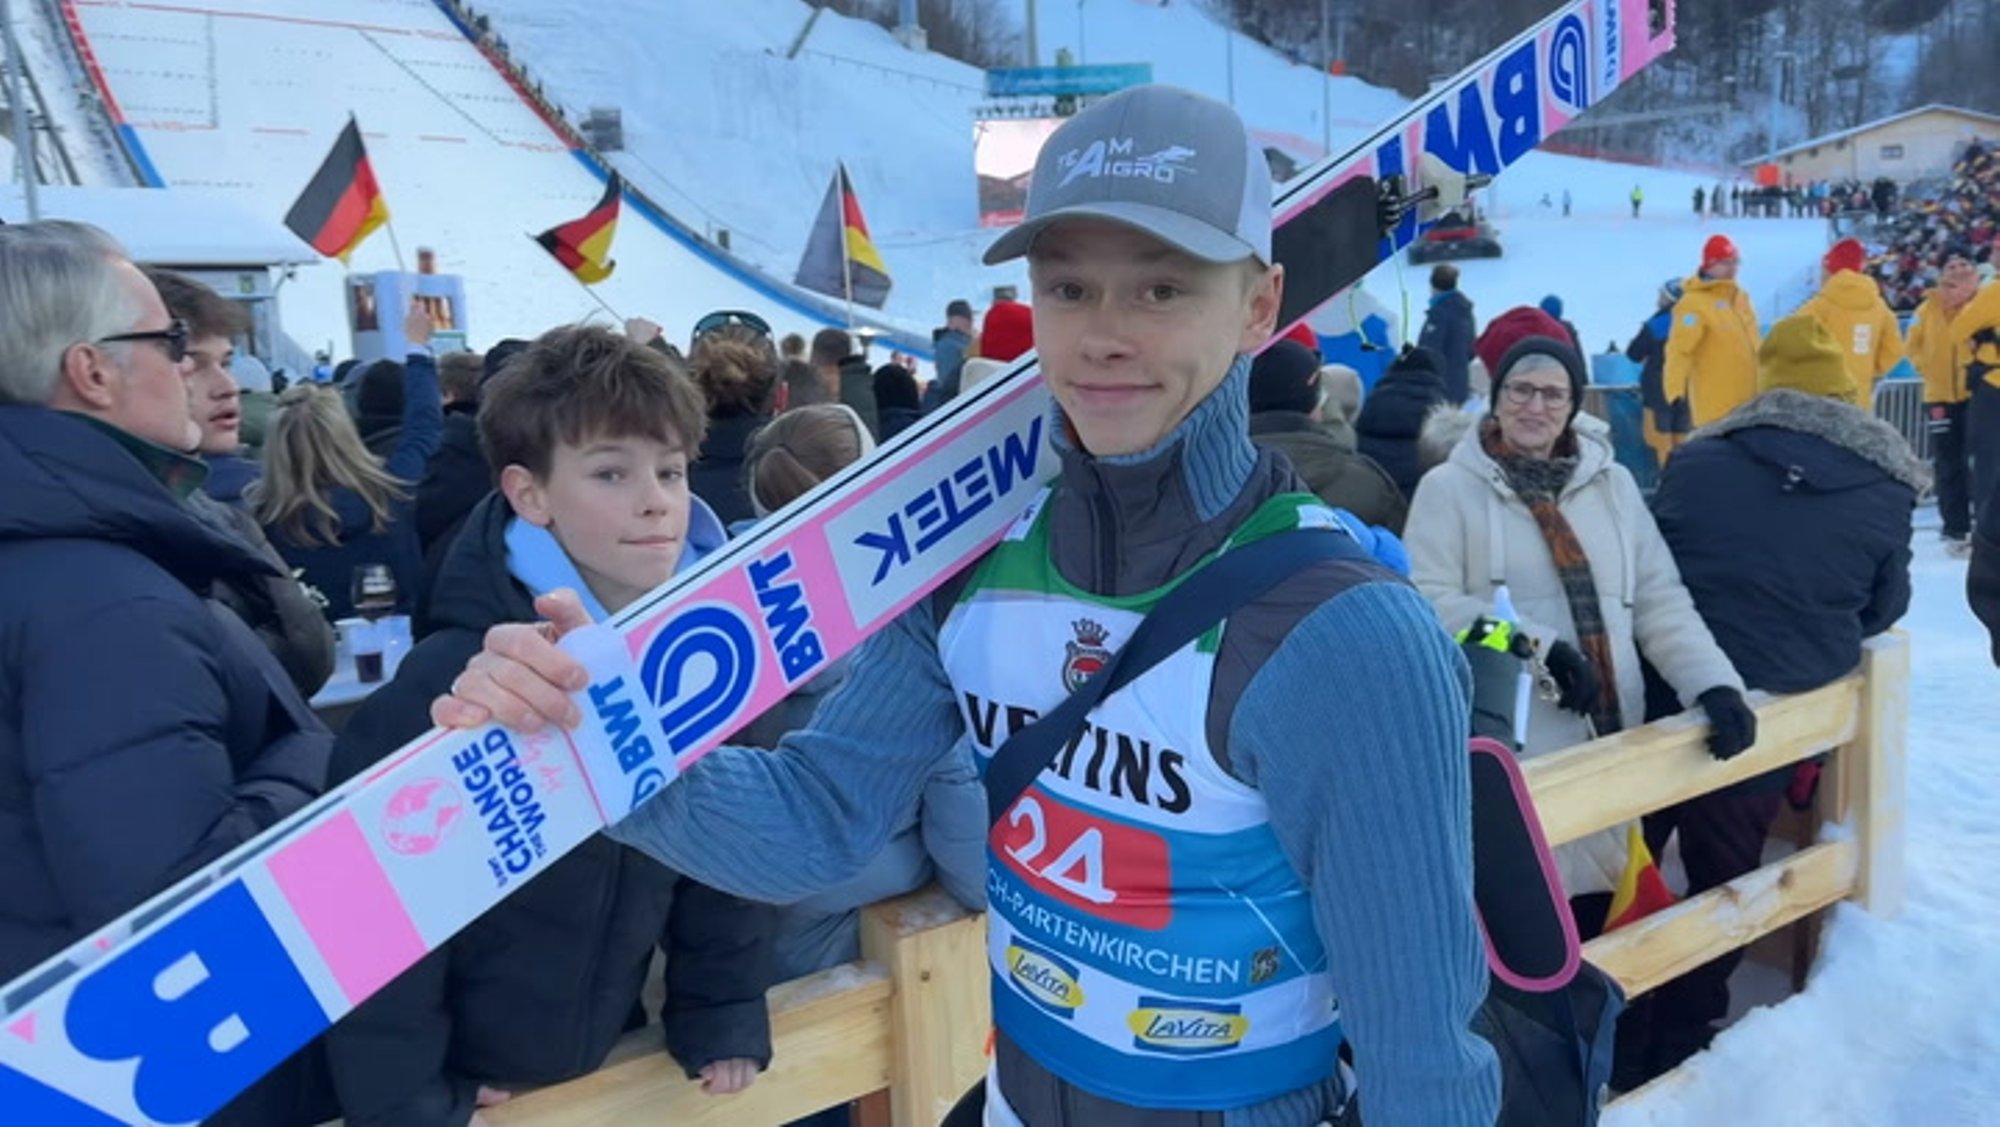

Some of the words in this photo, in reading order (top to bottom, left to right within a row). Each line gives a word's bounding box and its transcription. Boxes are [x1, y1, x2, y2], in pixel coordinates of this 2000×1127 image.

[853, 415, 1042, 587] METEK
[747, 550, 825, 683] BWT
[482, 728, 546, 837] WORLD
[586, 675, 655, 776] BWT
[964, 691, 1192, 814] VTINS
[451, 742, 533, 875] CHANGE
[1004, 796, 1117, 904] 24
